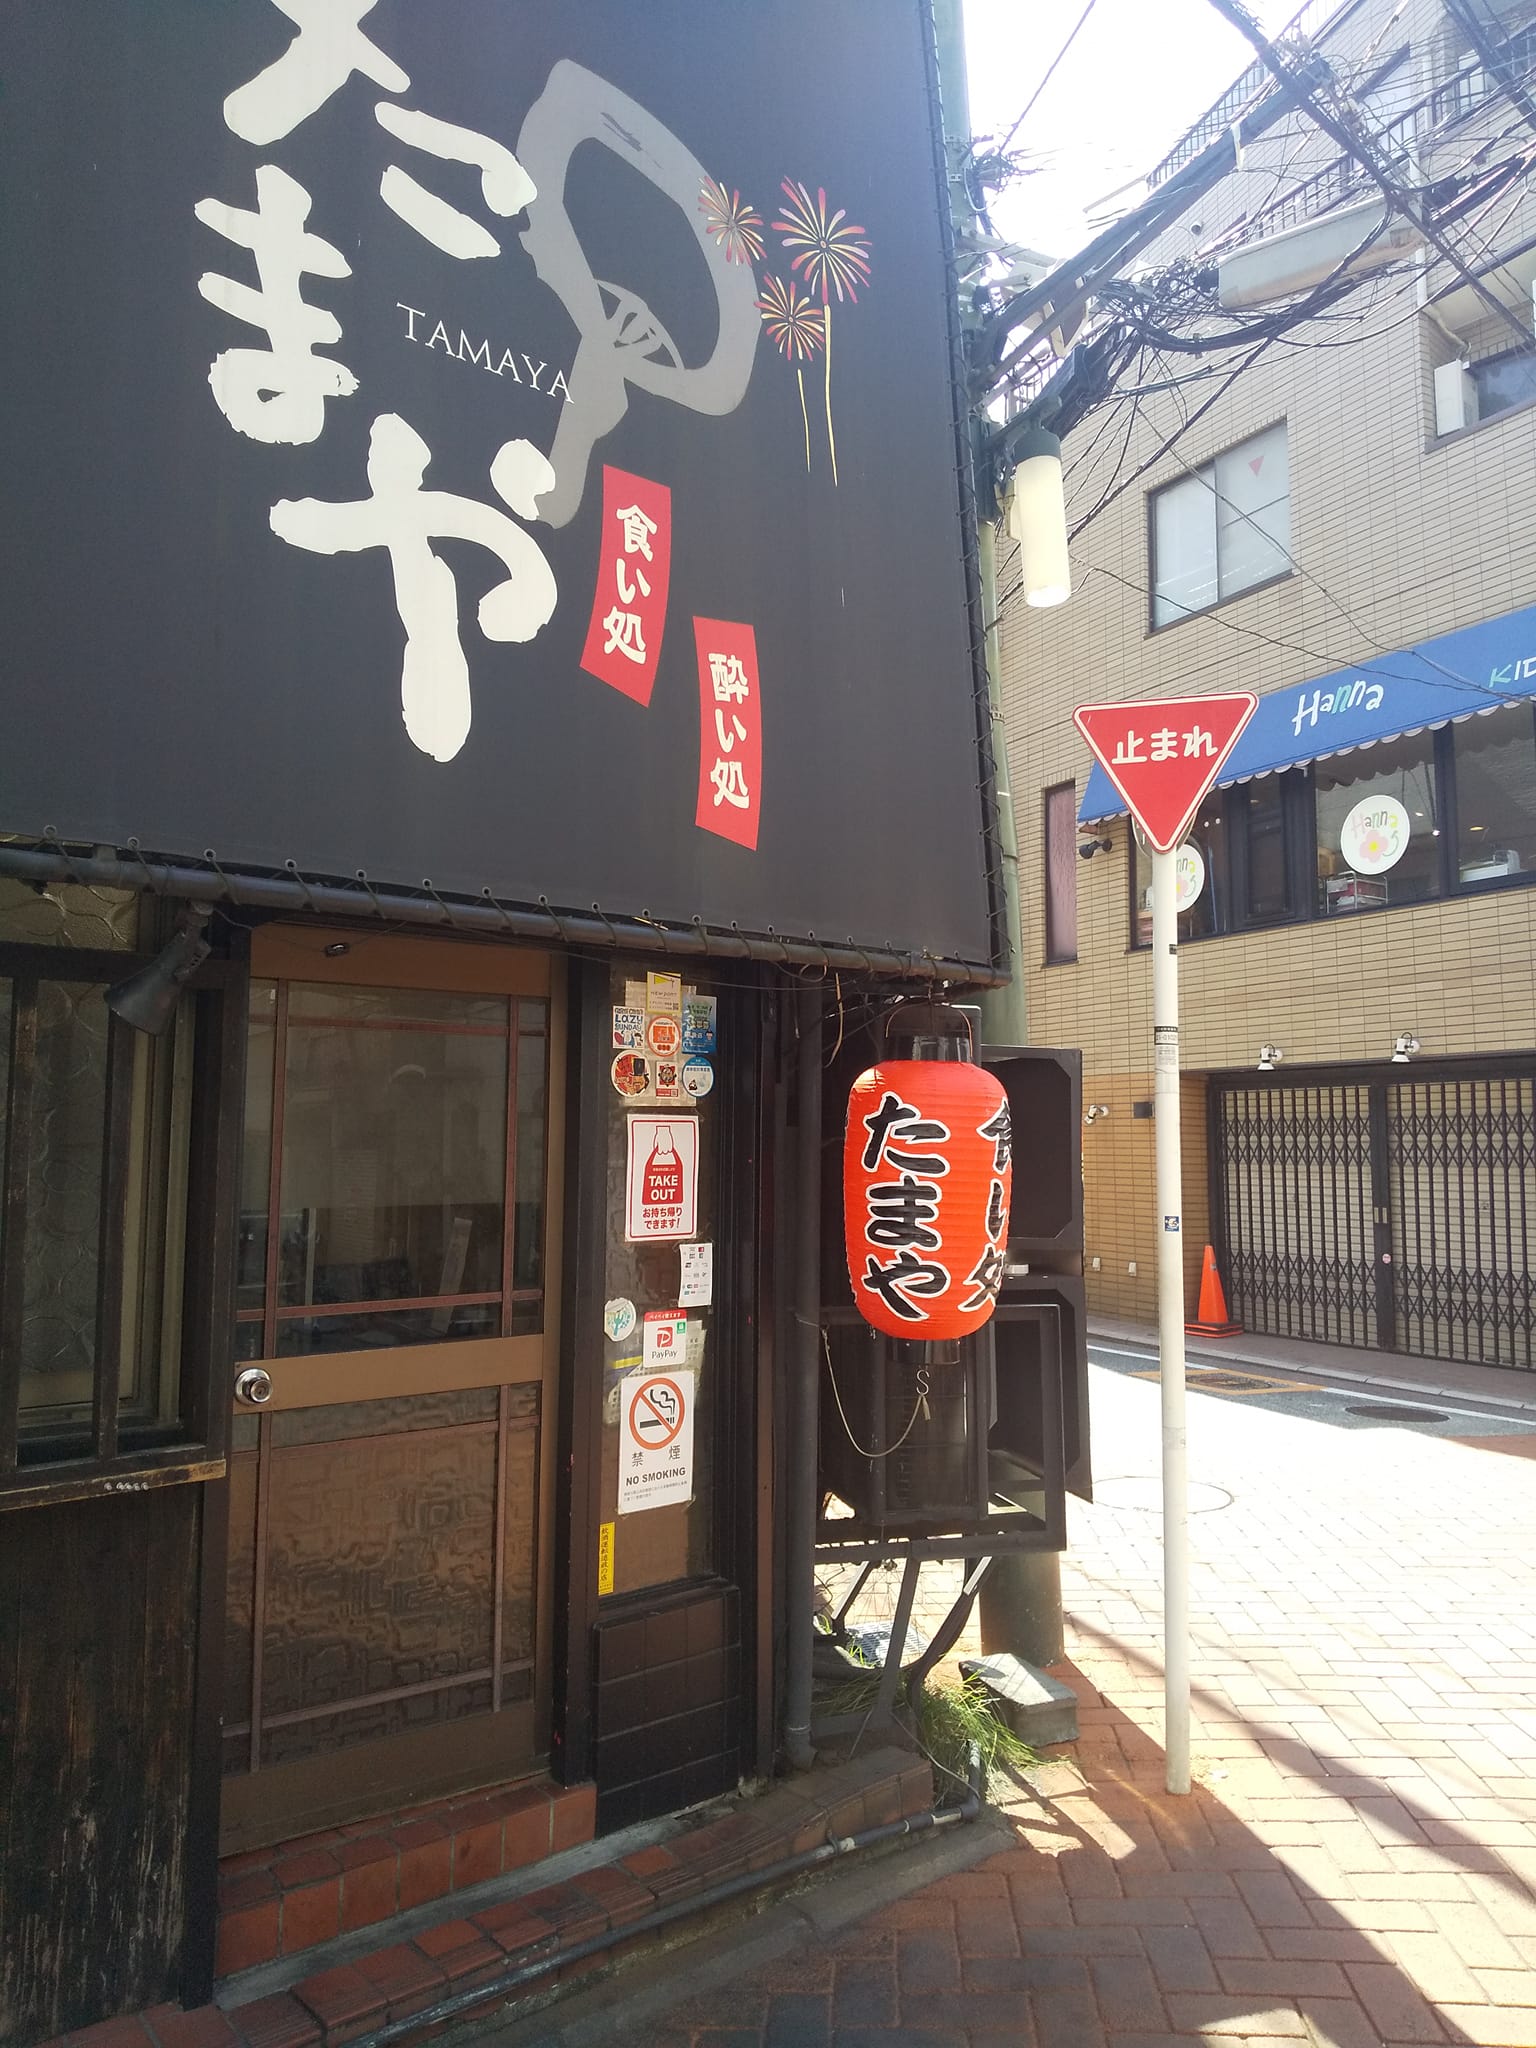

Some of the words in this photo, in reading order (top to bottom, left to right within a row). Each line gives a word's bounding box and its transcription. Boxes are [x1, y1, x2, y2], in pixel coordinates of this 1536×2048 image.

[396, 302, 576, 405] TAMAYA
[603, 504, 658, 665] 食い処
[1292, 680, 1384, 737] Hanna
[708, 652, 750, 809] 酔い処
[1111, 725, 1218, 765] 止まれ
[1352, 810, 1399, 839] Hanna
[648, 1175, 679, 1186] TAKE
[650, 1188, 676, 1201] OUT
[642, 1207, 683, 1218] お持ち帰り
[862, 1091, 951, 1320] たまや
[651, 1349, 678, 1360] PayPay
[626, 1475, 640, 1487] NO
[642, 1467, 686, 1483] SMOKING
